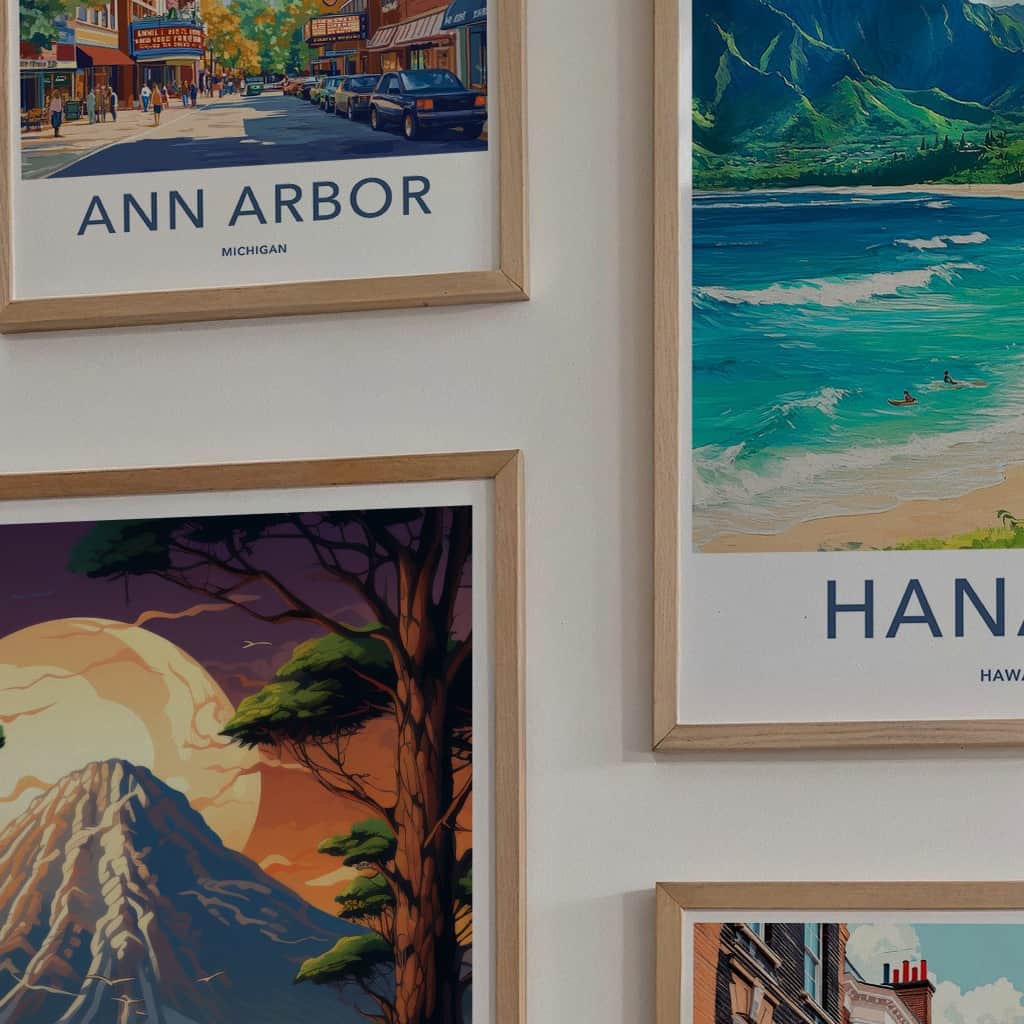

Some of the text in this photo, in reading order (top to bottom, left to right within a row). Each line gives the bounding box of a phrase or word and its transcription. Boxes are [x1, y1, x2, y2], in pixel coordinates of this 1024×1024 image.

[77, 175, 432, 236] ANN ARBOR
[221, 243, 287, 257] MICHIGAN
[826, 577, 1024, 639] HAN
[980, 668, 1024, 682] HAW
